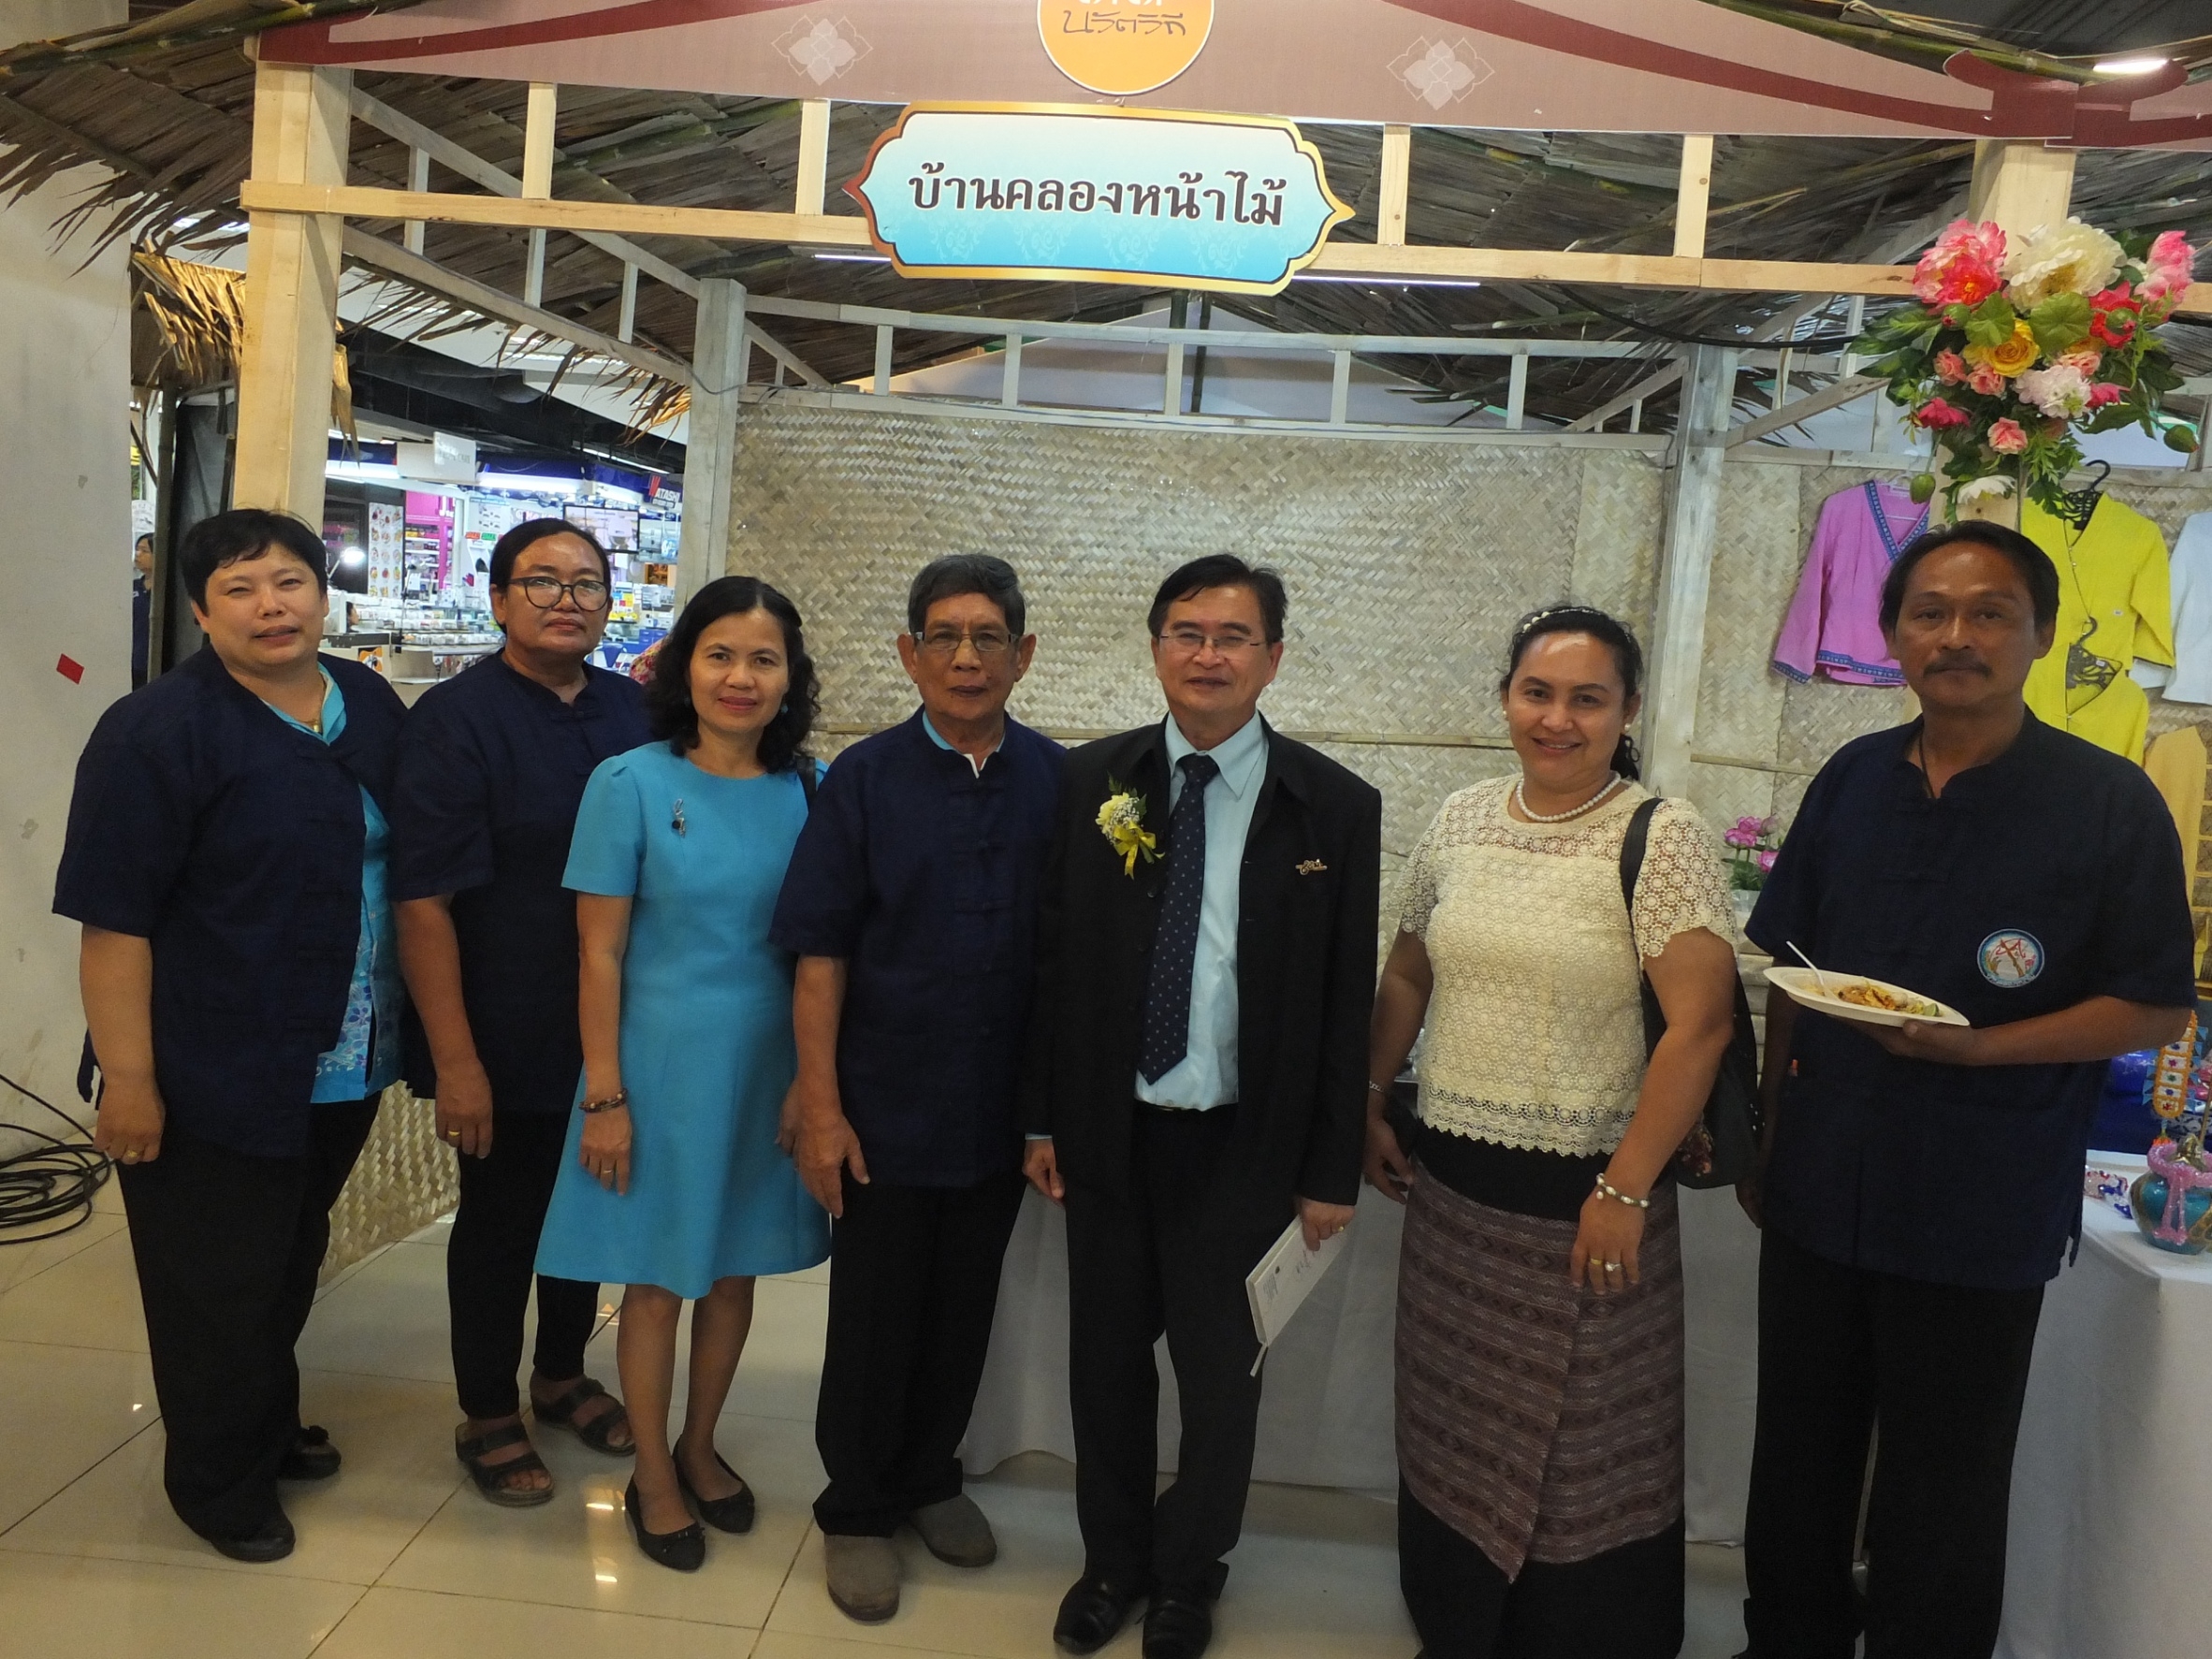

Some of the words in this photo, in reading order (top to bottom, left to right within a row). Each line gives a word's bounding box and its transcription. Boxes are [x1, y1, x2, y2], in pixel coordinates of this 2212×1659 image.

[908, 161, 1288, 226] บ้านคลองหน้าไม้
